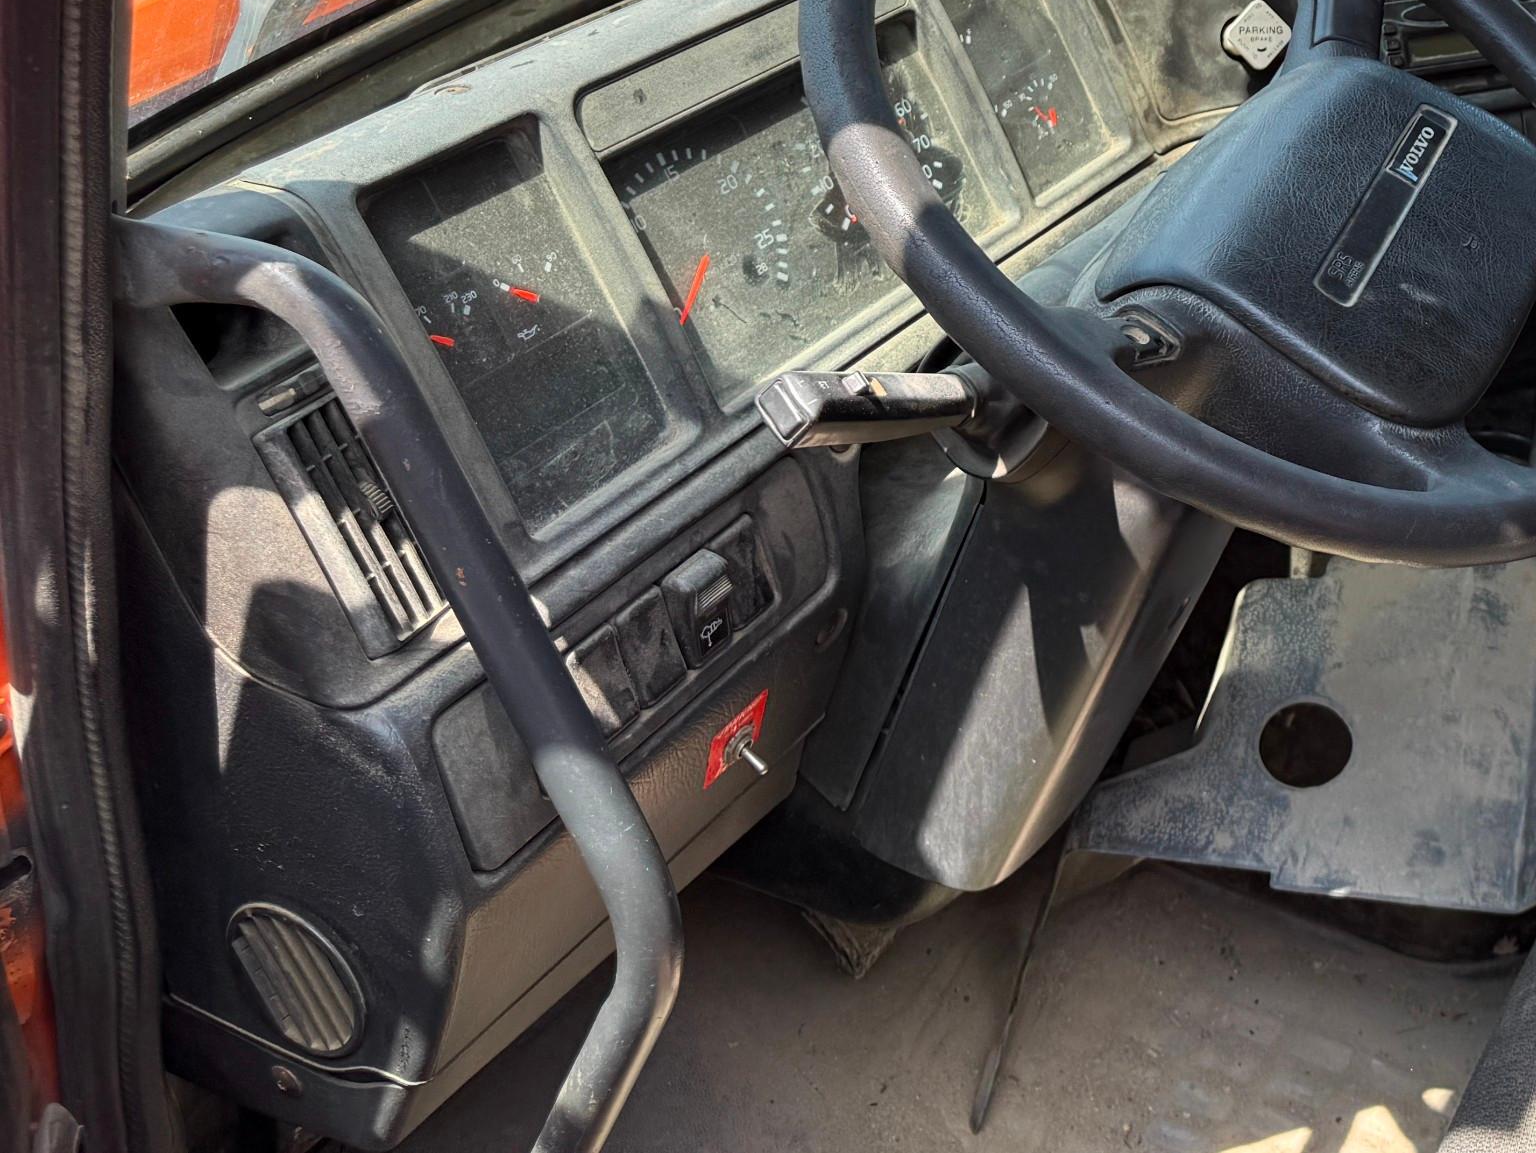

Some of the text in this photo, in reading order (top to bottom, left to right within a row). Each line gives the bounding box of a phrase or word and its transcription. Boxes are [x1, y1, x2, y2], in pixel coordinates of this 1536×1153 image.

[1239, 26, 1284, 35] PARKING
[894, 98, 912, 117] 60
[912, 134, 931, 154] 70
[1400, 125, 1435, 174] VOLVO
[663, 164, 681, 182] 15
[717, 174, 738, 195] 20
[630, 214, 647, 233] 10
[754, 228, 775, 250] 25
[755, 262, 769, 276] 28
[1327, 251, 1352, 281] SRS
[492, 278, 500, 288] 0
[461, 290, 478, 305] 230
